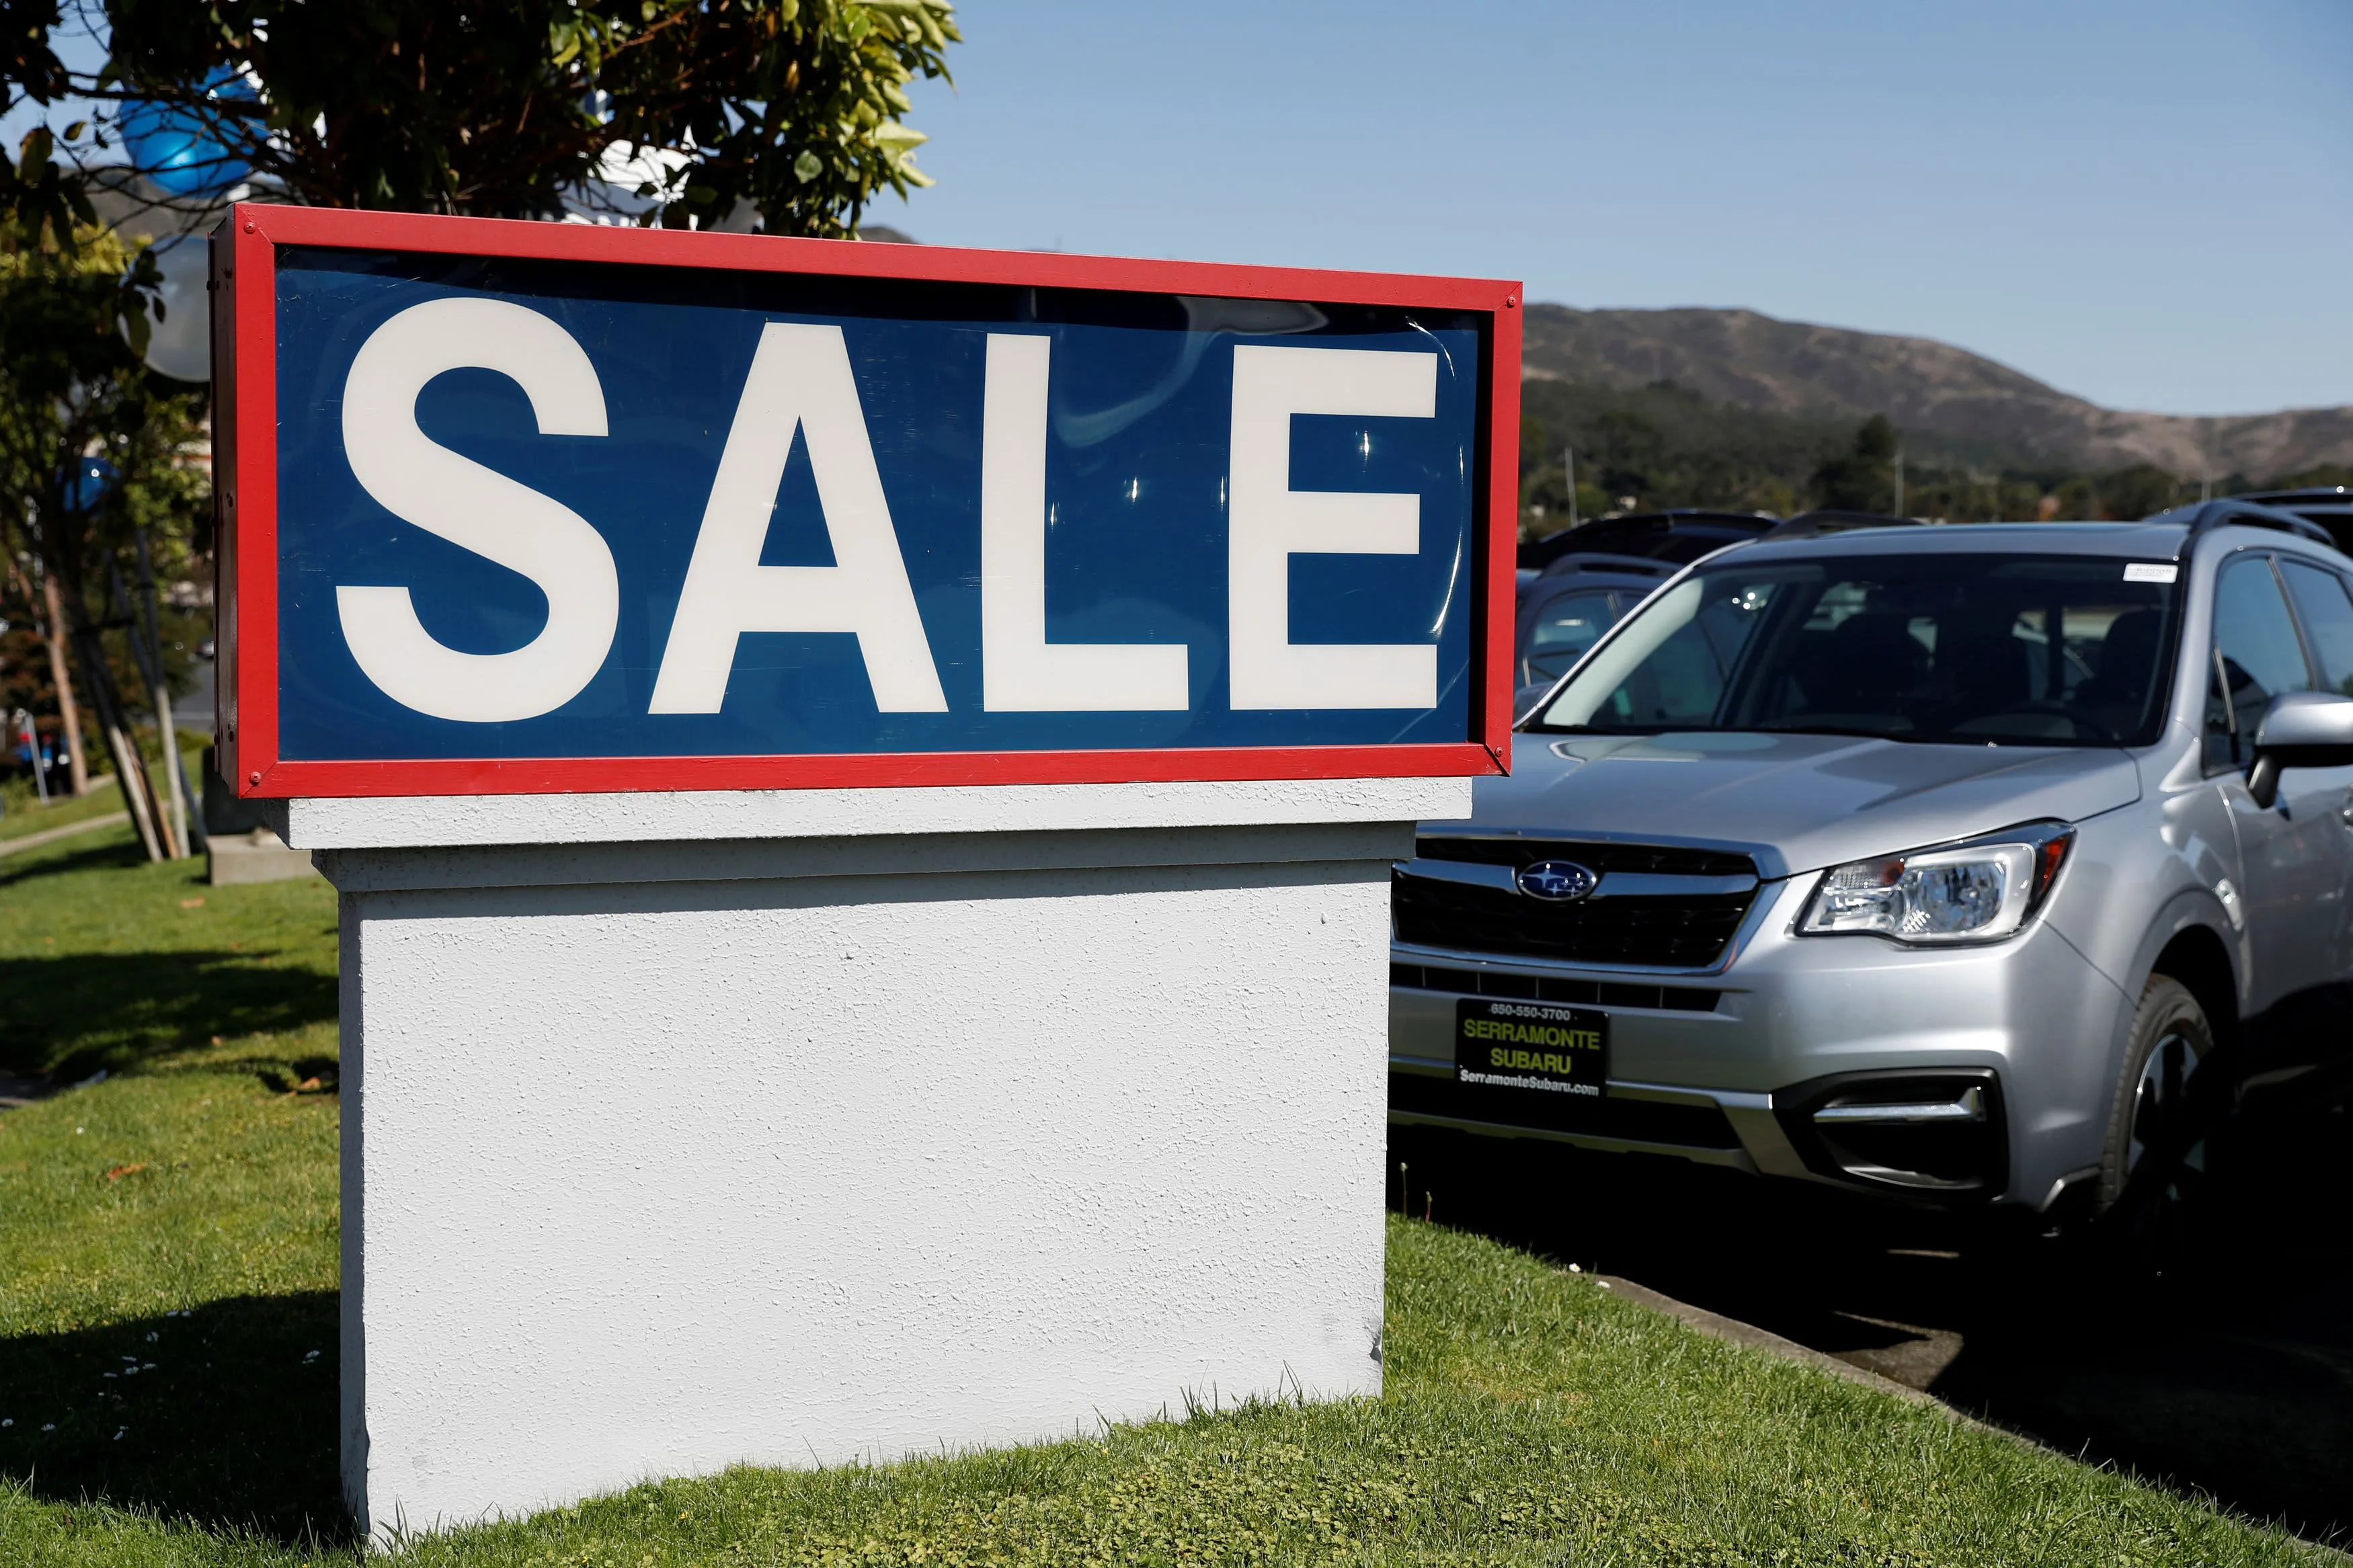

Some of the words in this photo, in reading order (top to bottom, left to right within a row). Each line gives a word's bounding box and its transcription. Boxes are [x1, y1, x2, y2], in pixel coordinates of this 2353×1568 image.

[336, 297, 1438, 723] SALE
[1464, 1019, 1601, 1050] SERRAMONTE
[1490, 1048, 1572, 1074] SUBARU
[1460, 1069, 1599, 1096] SerramonteSubaru.com
